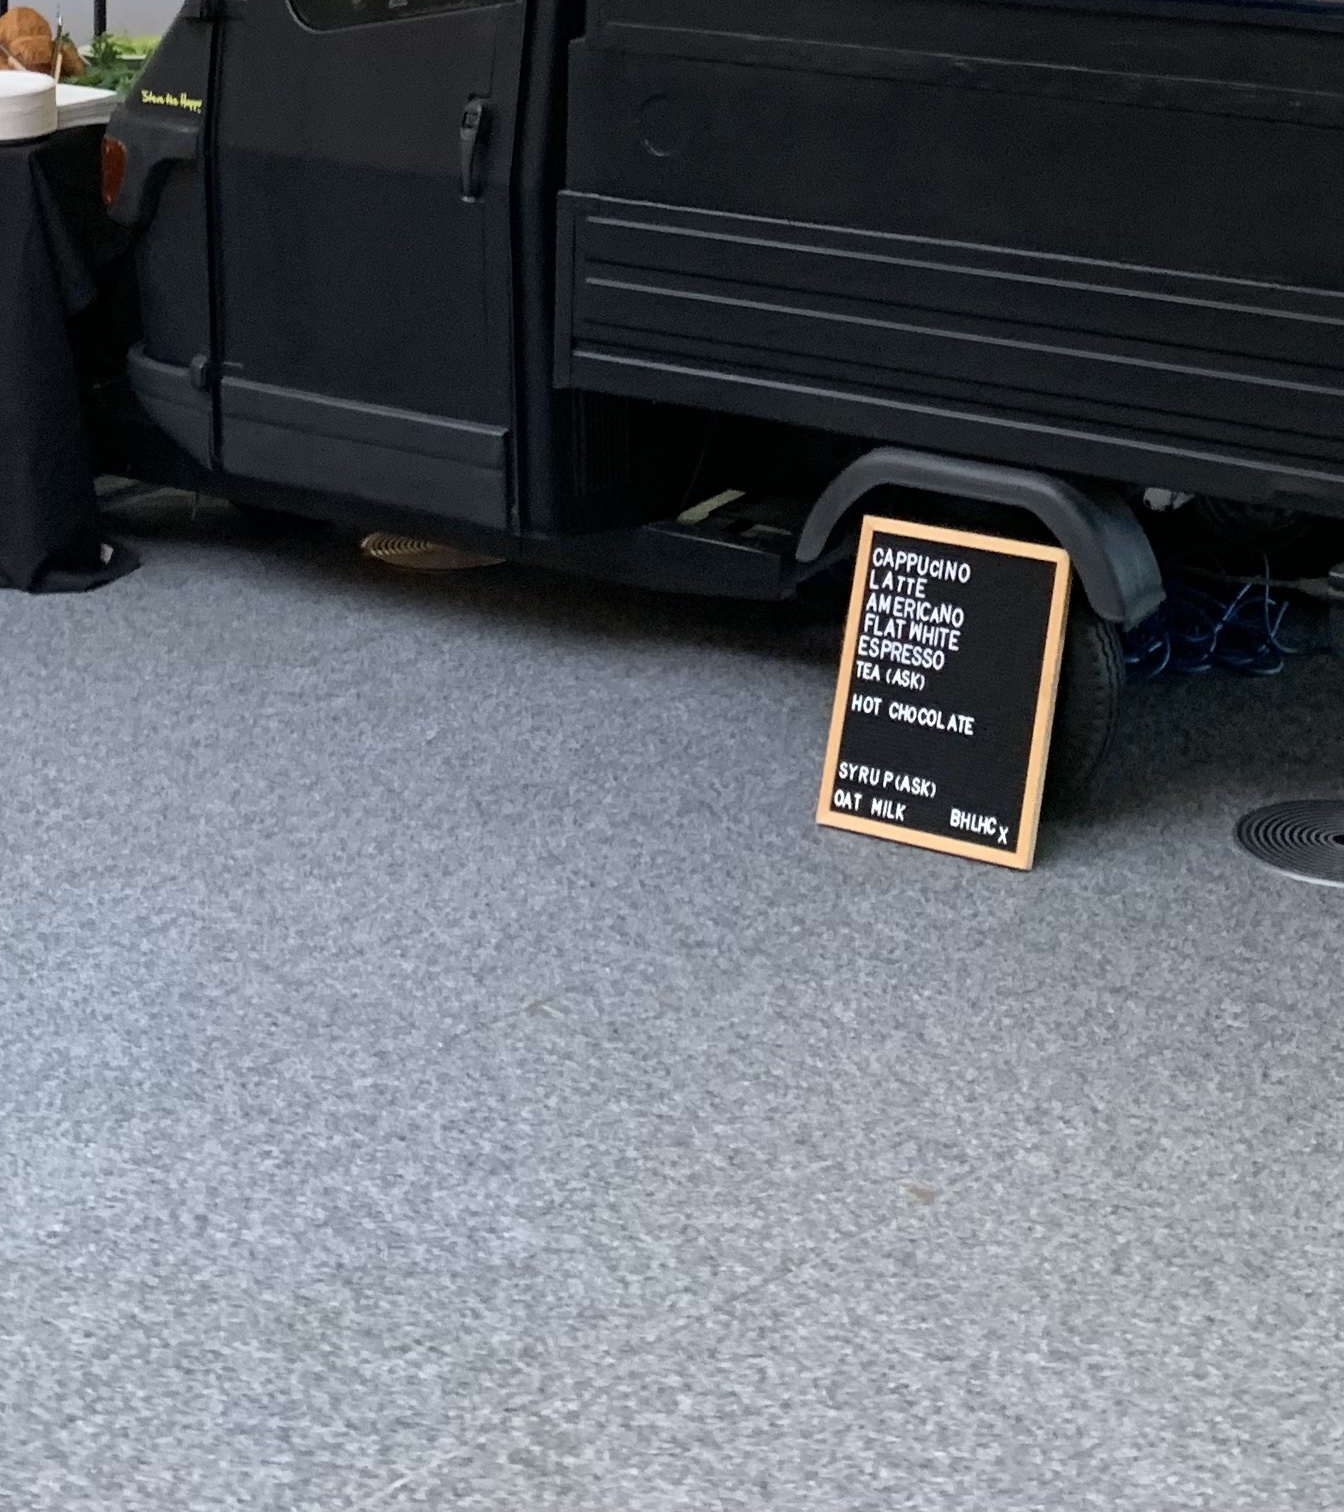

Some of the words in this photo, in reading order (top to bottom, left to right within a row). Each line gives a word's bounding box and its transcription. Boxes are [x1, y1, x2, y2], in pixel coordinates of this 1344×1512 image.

[869, 569, 928, 598] LATTE
[866, 592, 965, 628] AMERICANO
[864, 613, 907, 639] FLAT
[909, 620, 961, 651] WHITE
[858, 634, 945, 670] ESPRESSO
[856, 660, 881, 681] TEA
[885, 668, 926, 691] (ASK)
[851, 693, 882, 715] HOT
[888, 701, 975, 735] CHOCOLATE
[834, 789, 863, 811] OAT
[870, 798, 907, 822] MILK
